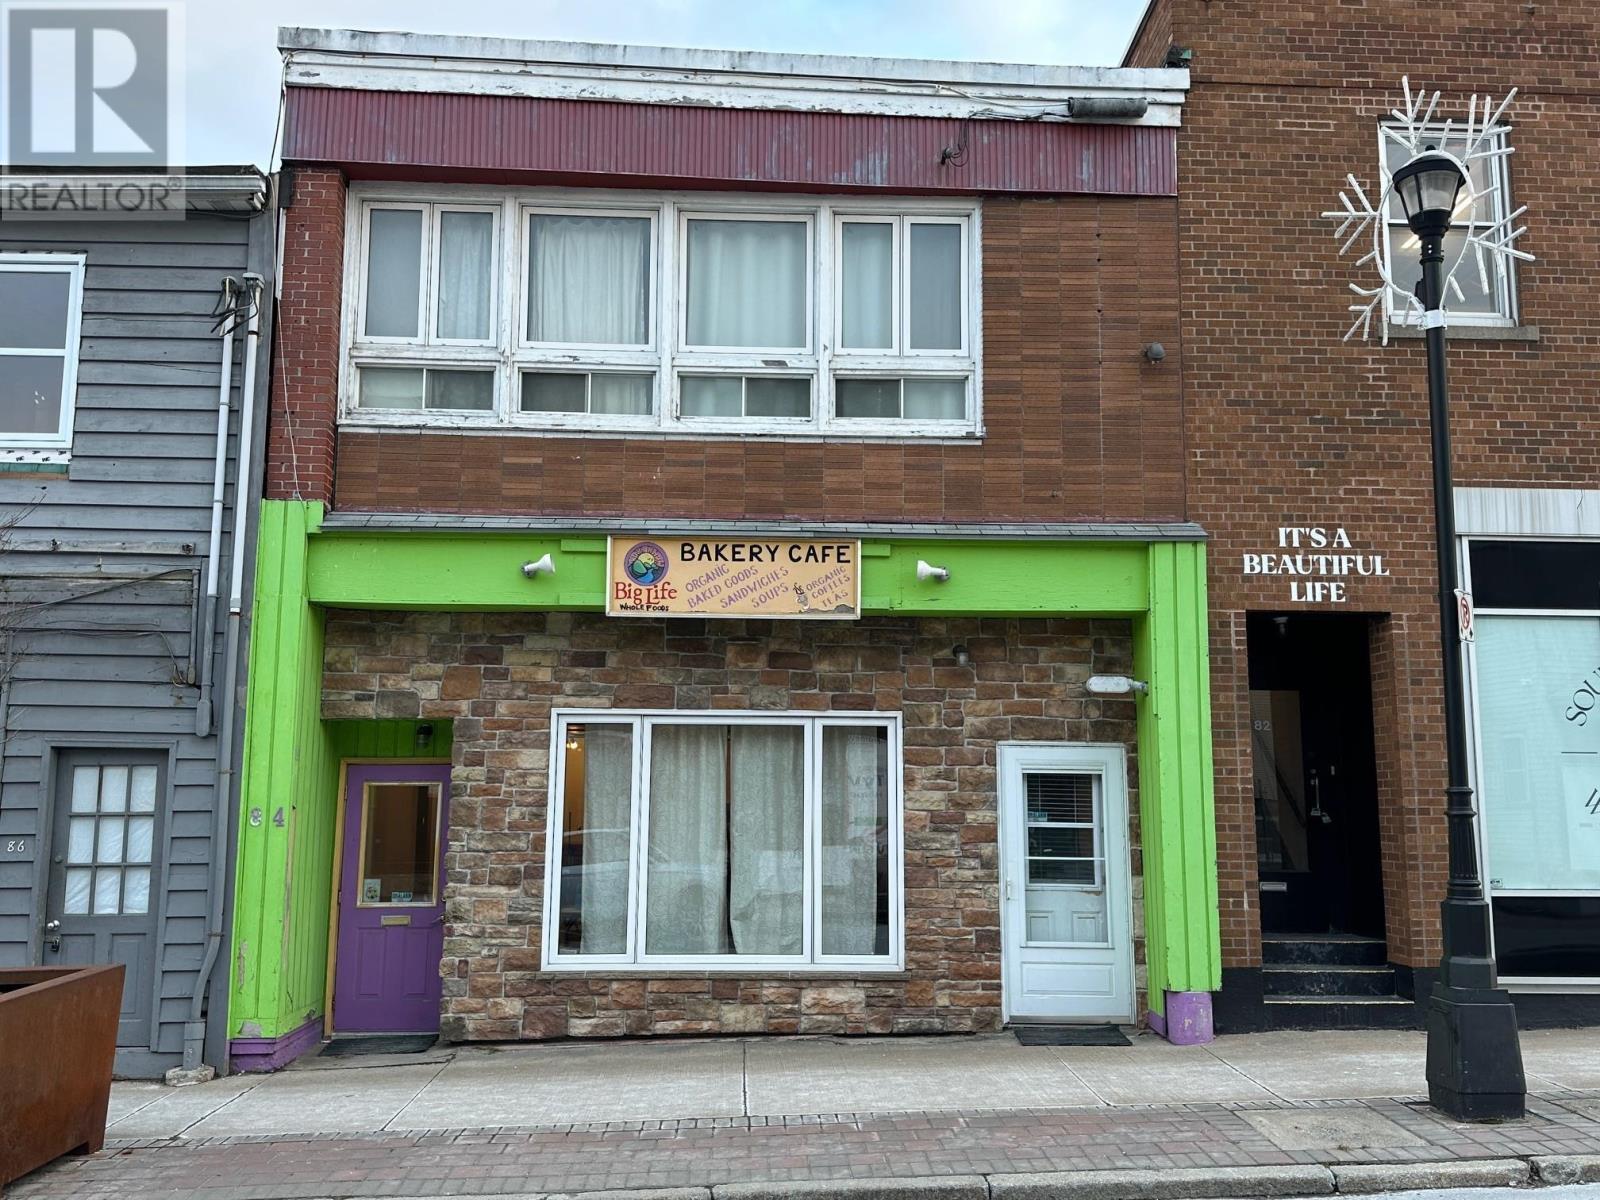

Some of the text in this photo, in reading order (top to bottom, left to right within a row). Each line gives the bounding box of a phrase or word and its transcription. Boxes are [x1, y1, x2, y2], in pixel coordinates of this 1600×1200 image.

[1278, 527, 1352, 548] IT'S A
[680, 542, 851, 563] BAKERY CAFE
[1242, 553, 1390, 576] BEAUTIFUL
[685, 563, 730, 593] ORGANIC
[687, 565, 759, 608] BAKED GOODS
[720, 566, 789, 608] SANDWICHES
[806, 566, 847, 591] ORGANIC
[614, 581, 678, 606] Big Life
[751, 582, 789, 608] SOUPS
[822, 589, 849, 608] TEAS
[1290, 581, 1347, 602] LIFE
[1565, 666, 1600, 727] SOU
[1254, 720, 1271, 731] 82
[7, 840, 25, 852] 86
